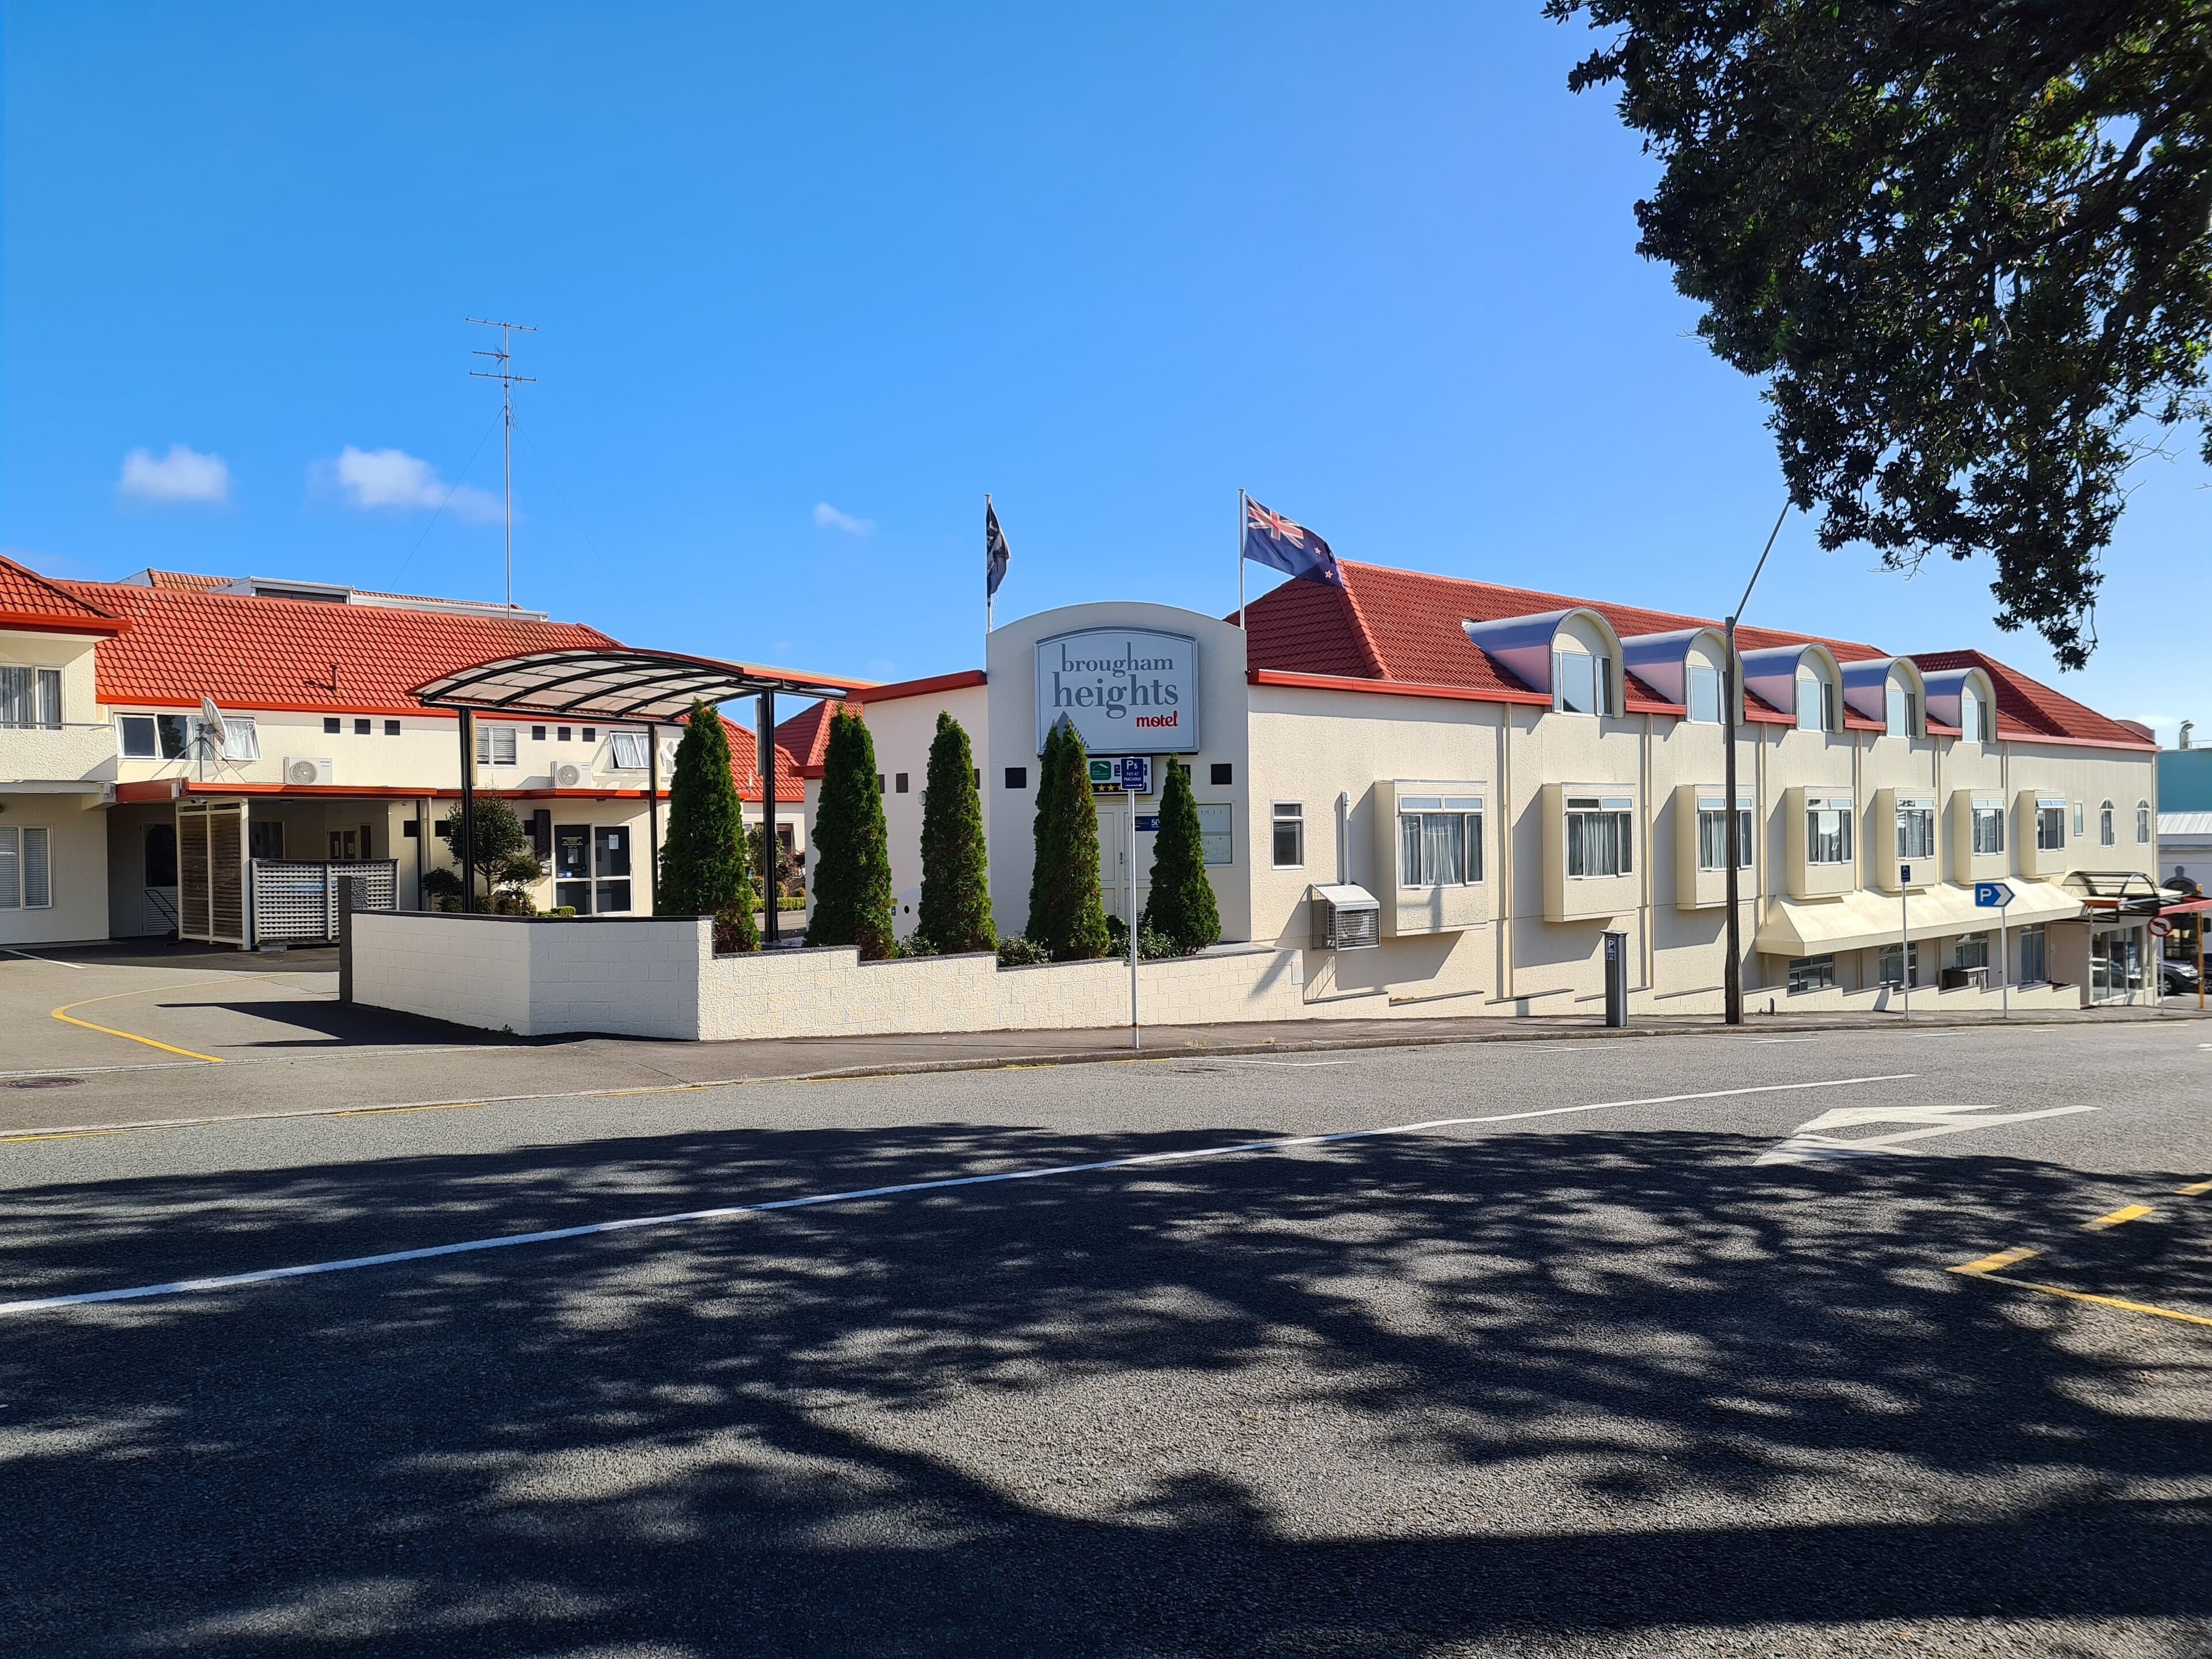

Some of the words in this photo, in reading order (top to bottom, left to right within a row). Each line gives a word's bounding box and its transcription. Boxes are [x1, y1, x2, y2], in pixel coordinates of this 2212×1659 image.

[1060, 642, 1174, 677] brougham
[1052, 672, 1179, 719] heights
[1136, 710, 1179, 727] motel
[1980, 888, 1992, 902] P
[1608, 940, 1614, 948] P
